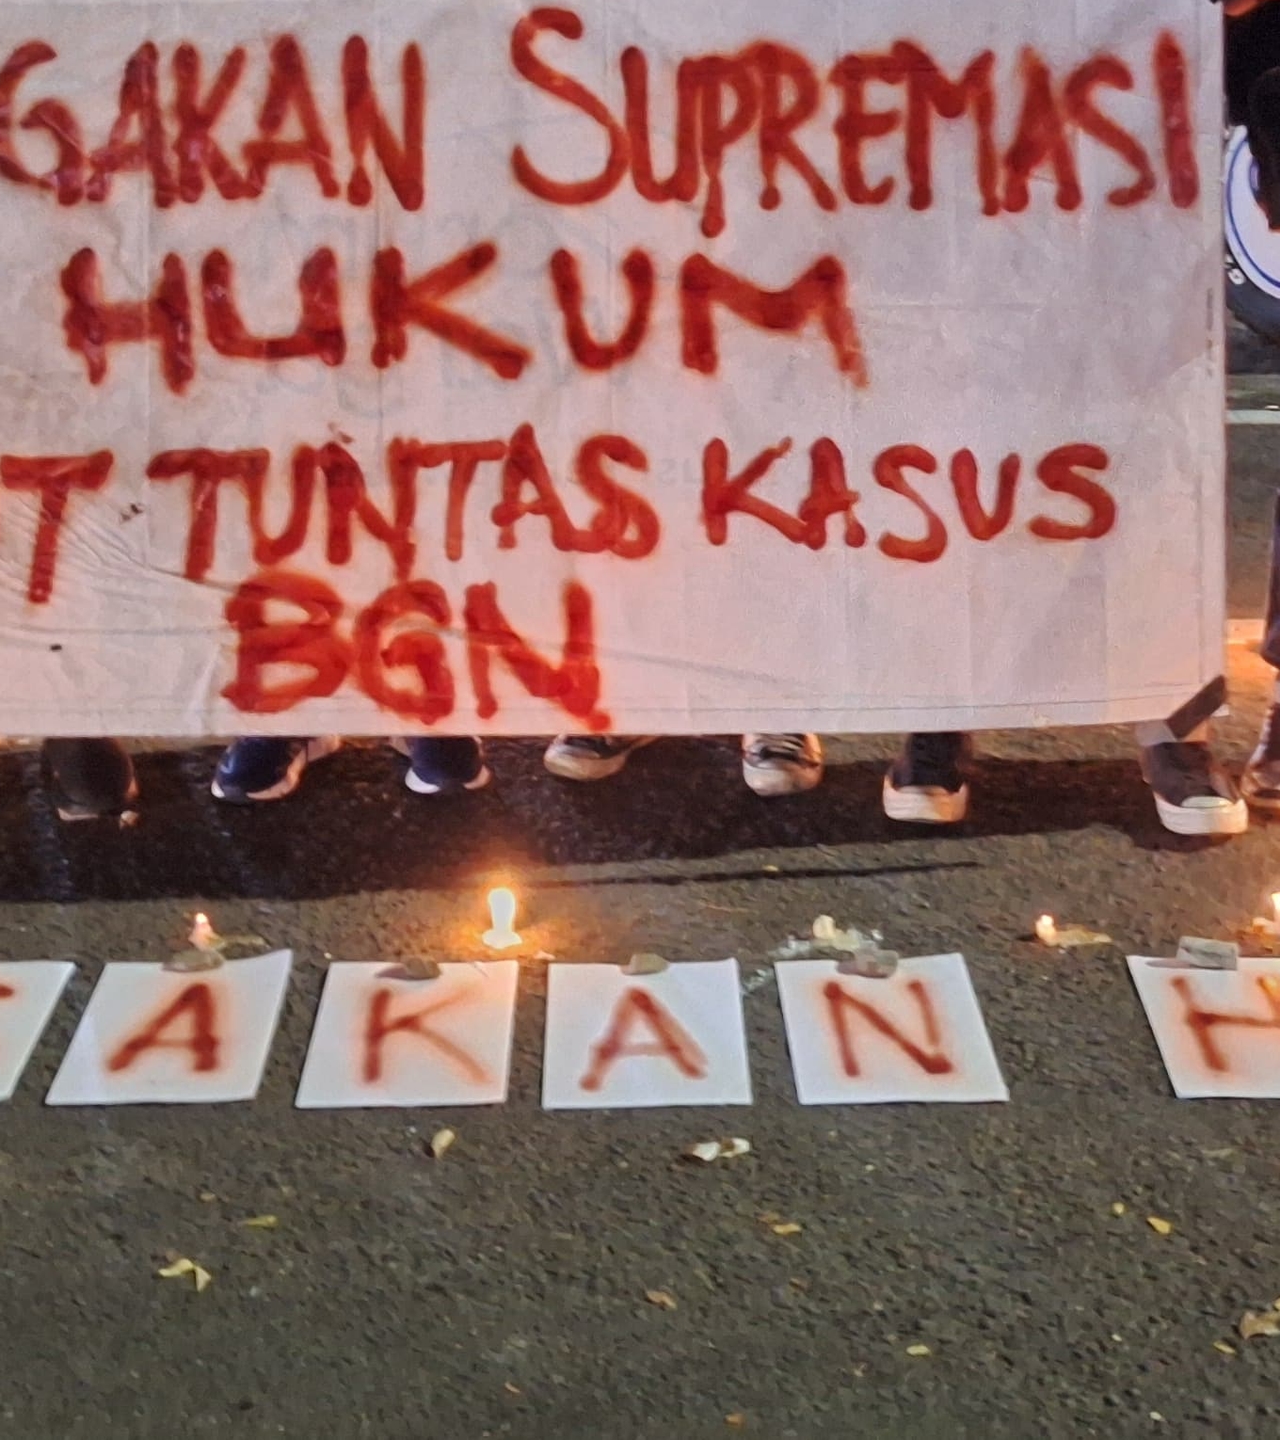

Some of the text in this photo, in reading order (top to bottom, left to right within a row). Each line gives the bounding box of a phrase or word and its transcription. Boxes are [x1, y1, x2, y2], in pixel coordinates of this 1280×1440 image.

[510, 6, 1199, 239] SUPREMASI
[58, 241, 869, 396] HUKUM
[145, 422, 663, 578] TUNTAS
[698, 437, 1118, 566] KASUS
[220, 572, 615, 734] BGN
